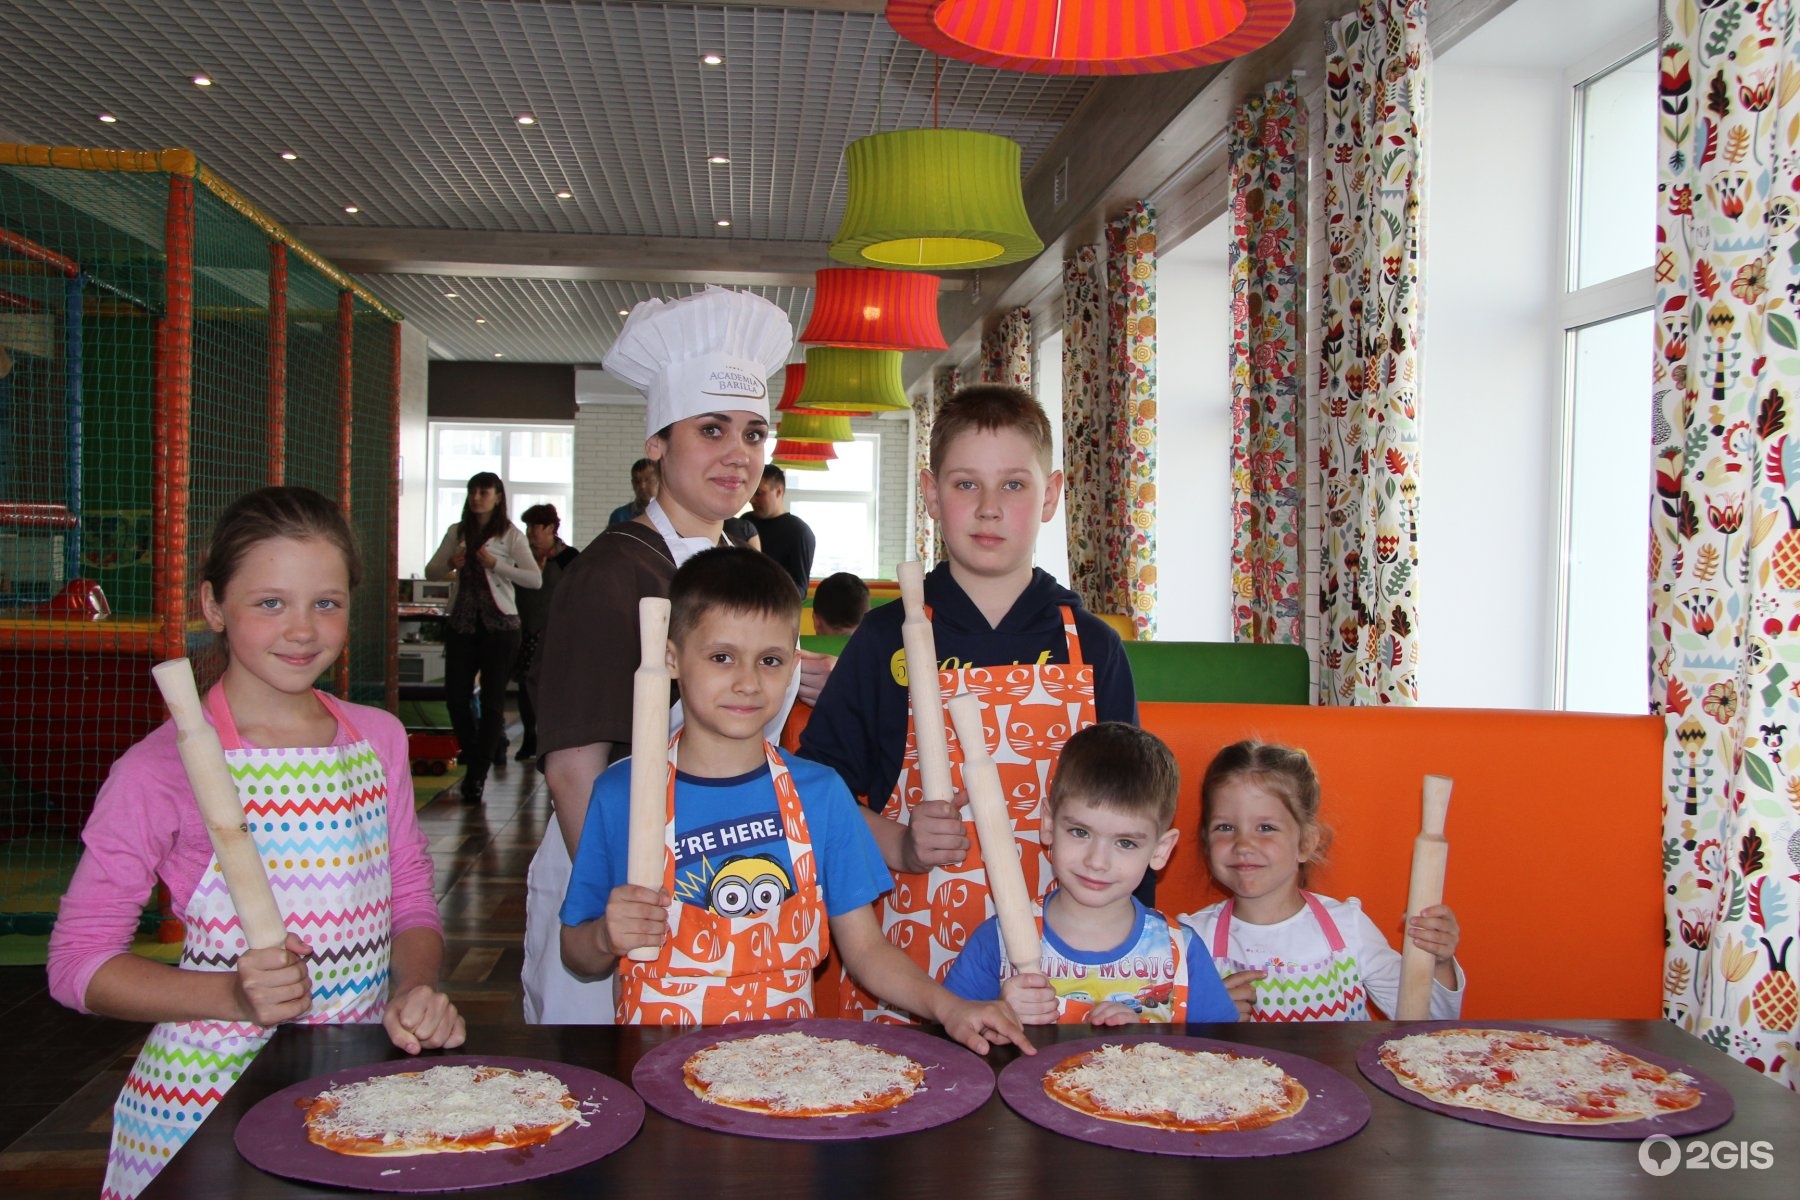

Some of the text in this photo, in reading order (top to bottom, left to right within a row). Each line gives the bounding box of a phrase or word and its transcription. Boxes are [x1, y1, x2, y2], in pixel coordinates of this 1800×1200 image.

[710, 372, 758, 387] ACADEMIA
[720, 381, 757, 393] BARILLA
[720, 818, 784, 847] HERE,
